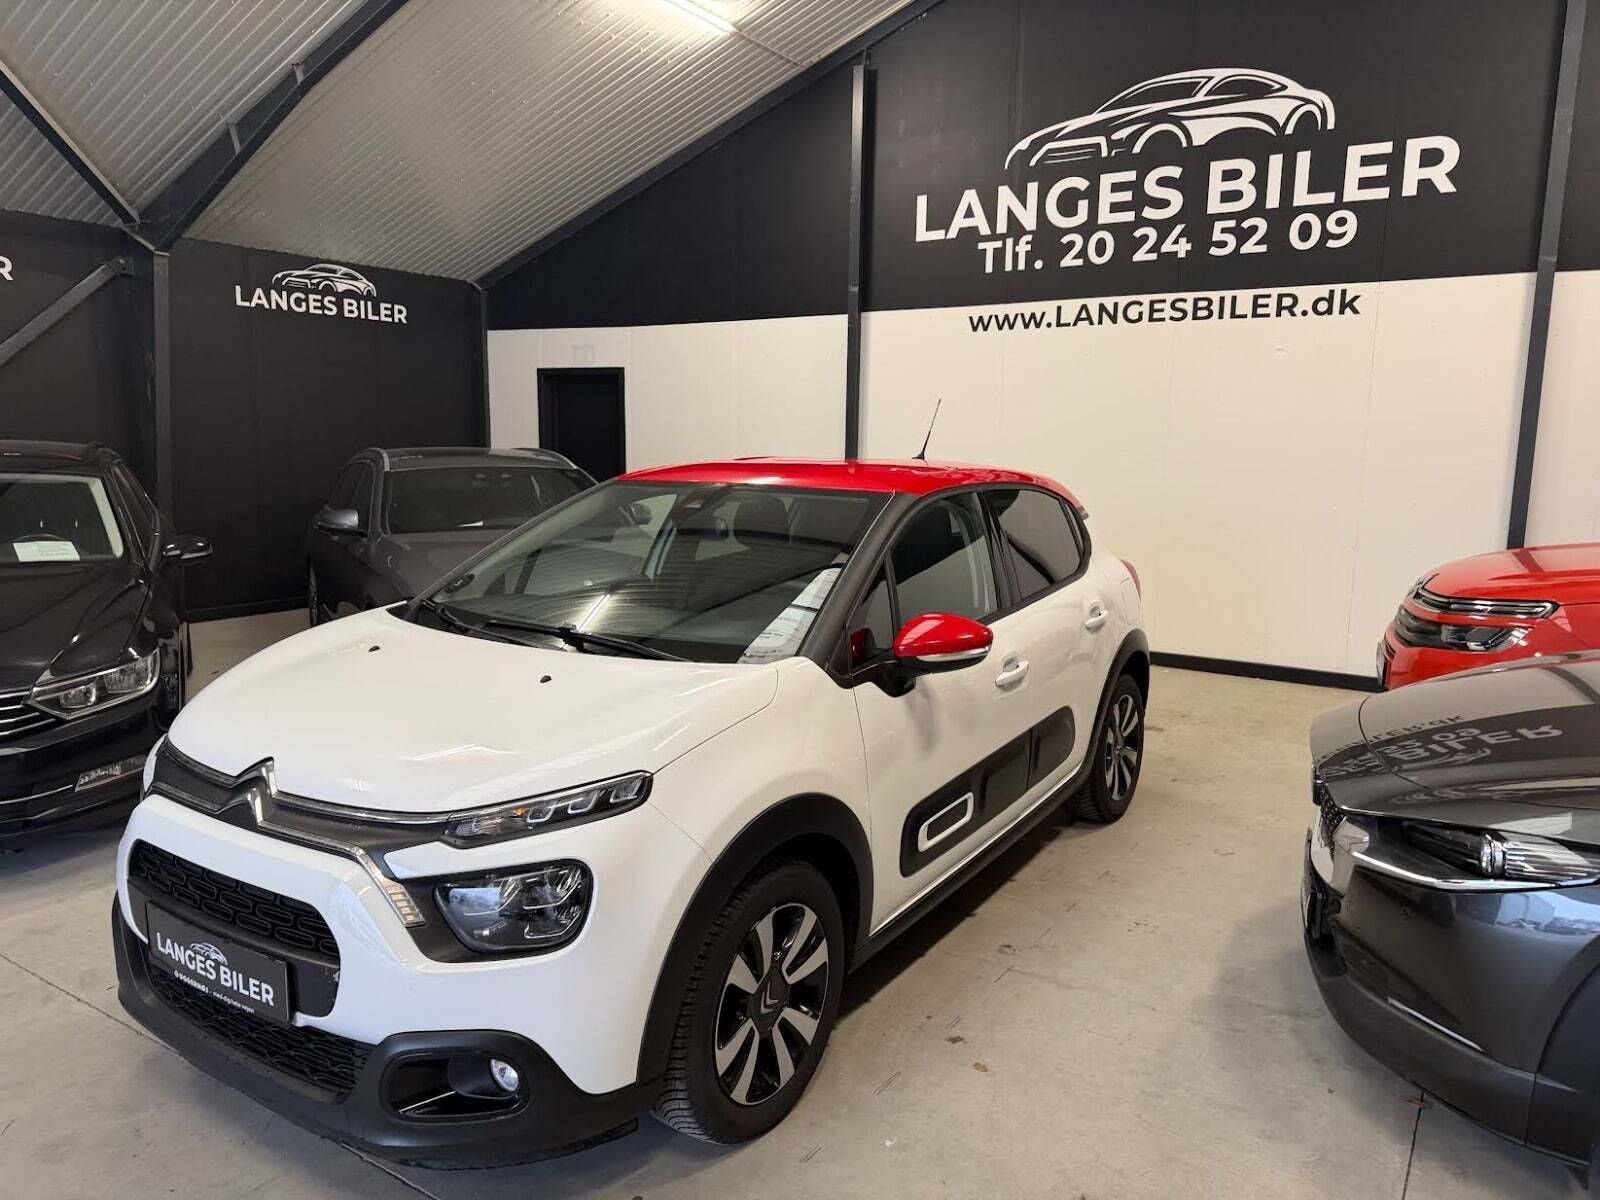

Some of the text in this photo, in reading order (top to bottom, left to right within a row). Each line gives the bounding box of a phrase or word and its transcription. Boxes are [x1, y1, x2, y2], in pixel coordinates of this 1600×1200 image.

[915, 135, 1461, 243] LANGES BILER
[977, 209, 1358, 274] Tlf. 20 24 52 09
[235, 285, 407, 324] LANGES BILER
[968, 288, 1361, 333] www.LANGESBILER.dk
[156, 932, 217, 981] LANGES
[219, 964, 275, 1007] BILER
